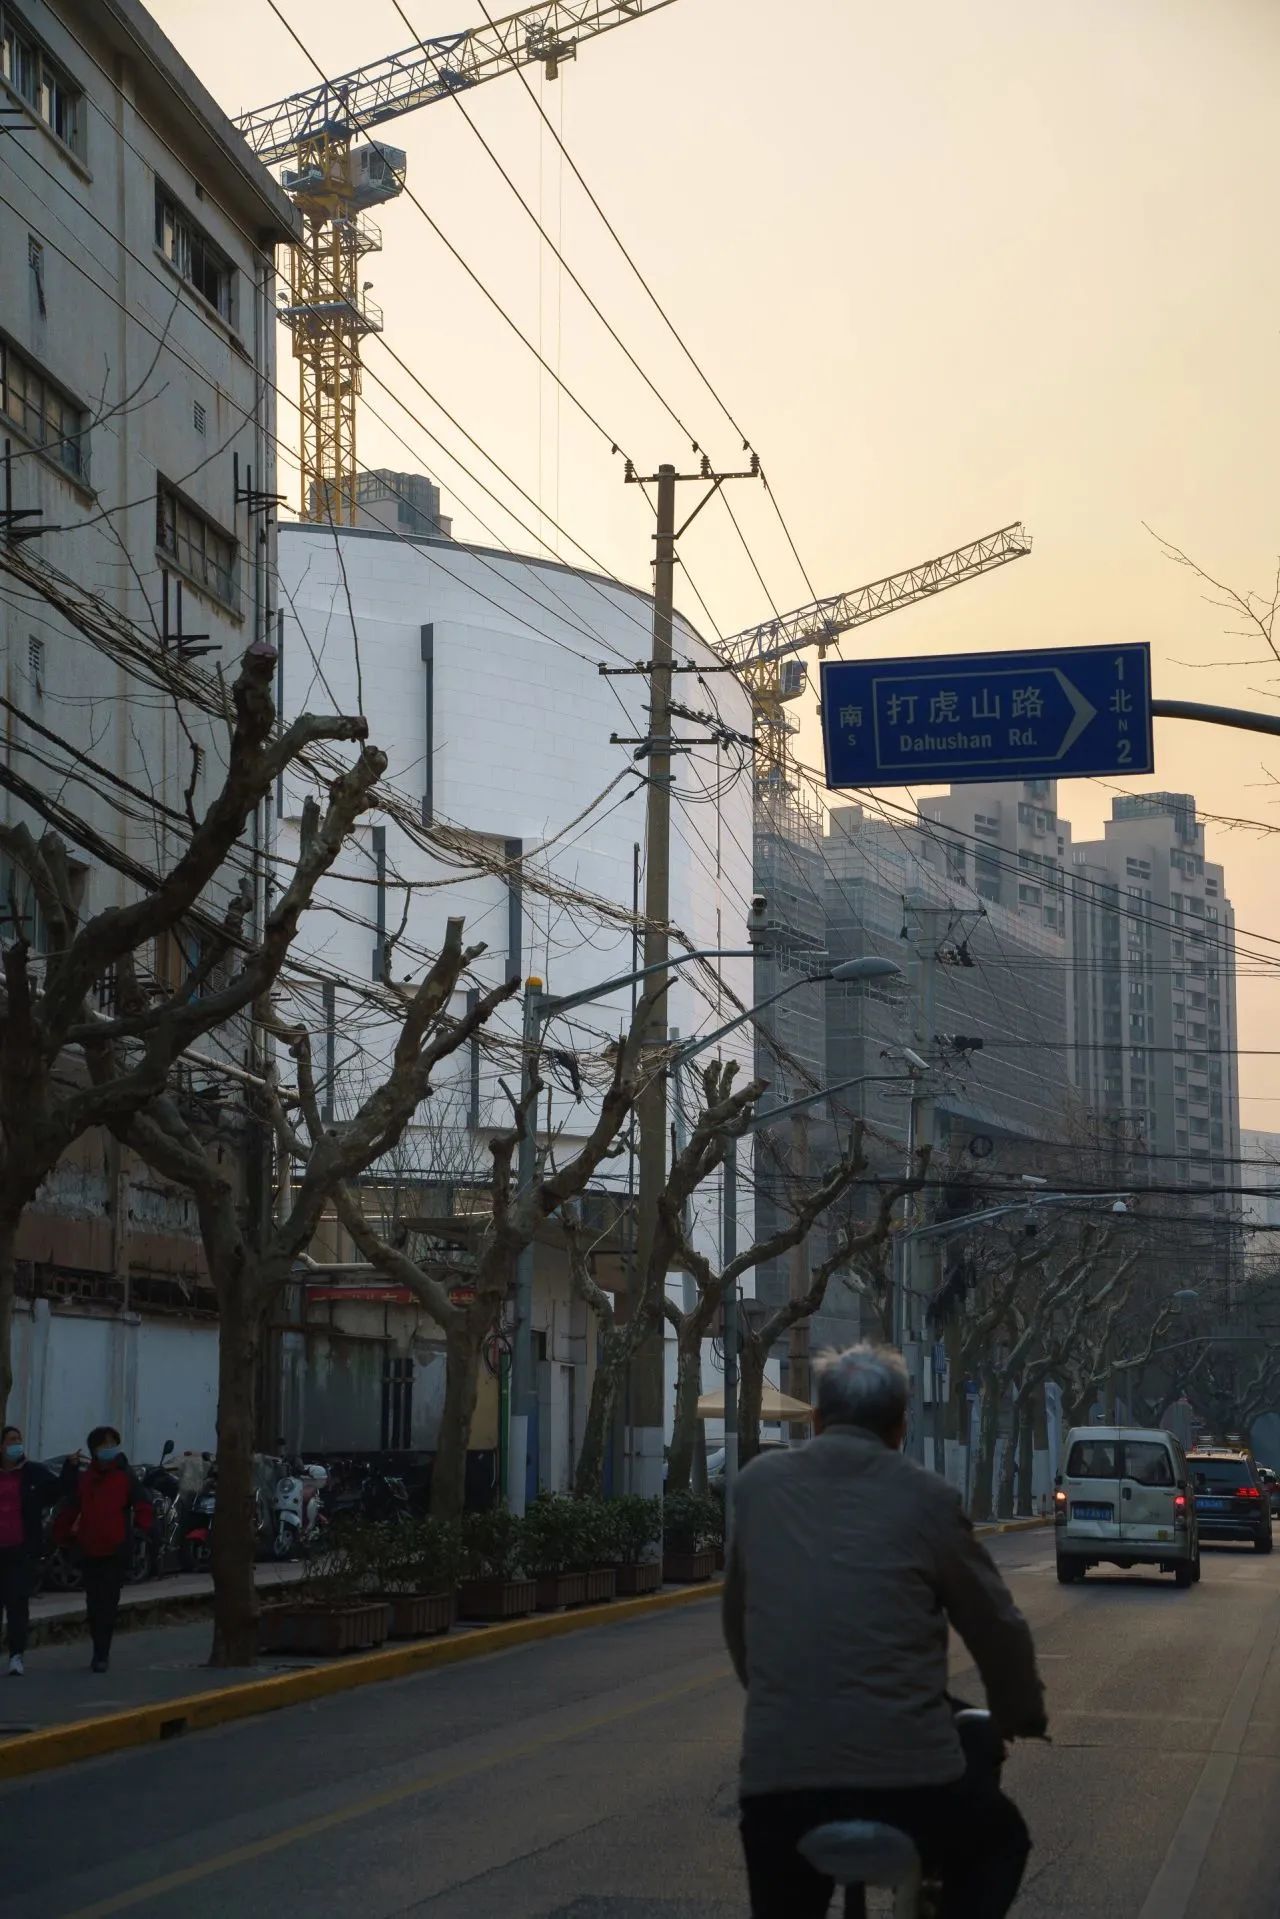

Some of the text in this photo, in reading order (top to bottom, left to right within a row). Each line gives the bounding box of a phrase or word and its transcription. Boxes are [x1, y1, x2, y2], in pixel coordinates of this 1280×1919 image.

[1115, 656, 1124, 680] 1
[887, 686, 1045, 726] 打虎山路
[1109, 689, 1132, 713] 北
[839, 704, 863, 728] 南
[1118, 719, 1128, 731] N
[848, 734, 857, 746] S
[900, 728, 1038, 753] Dahushan Rd.
[1116, 739, 1132, 763] 2
